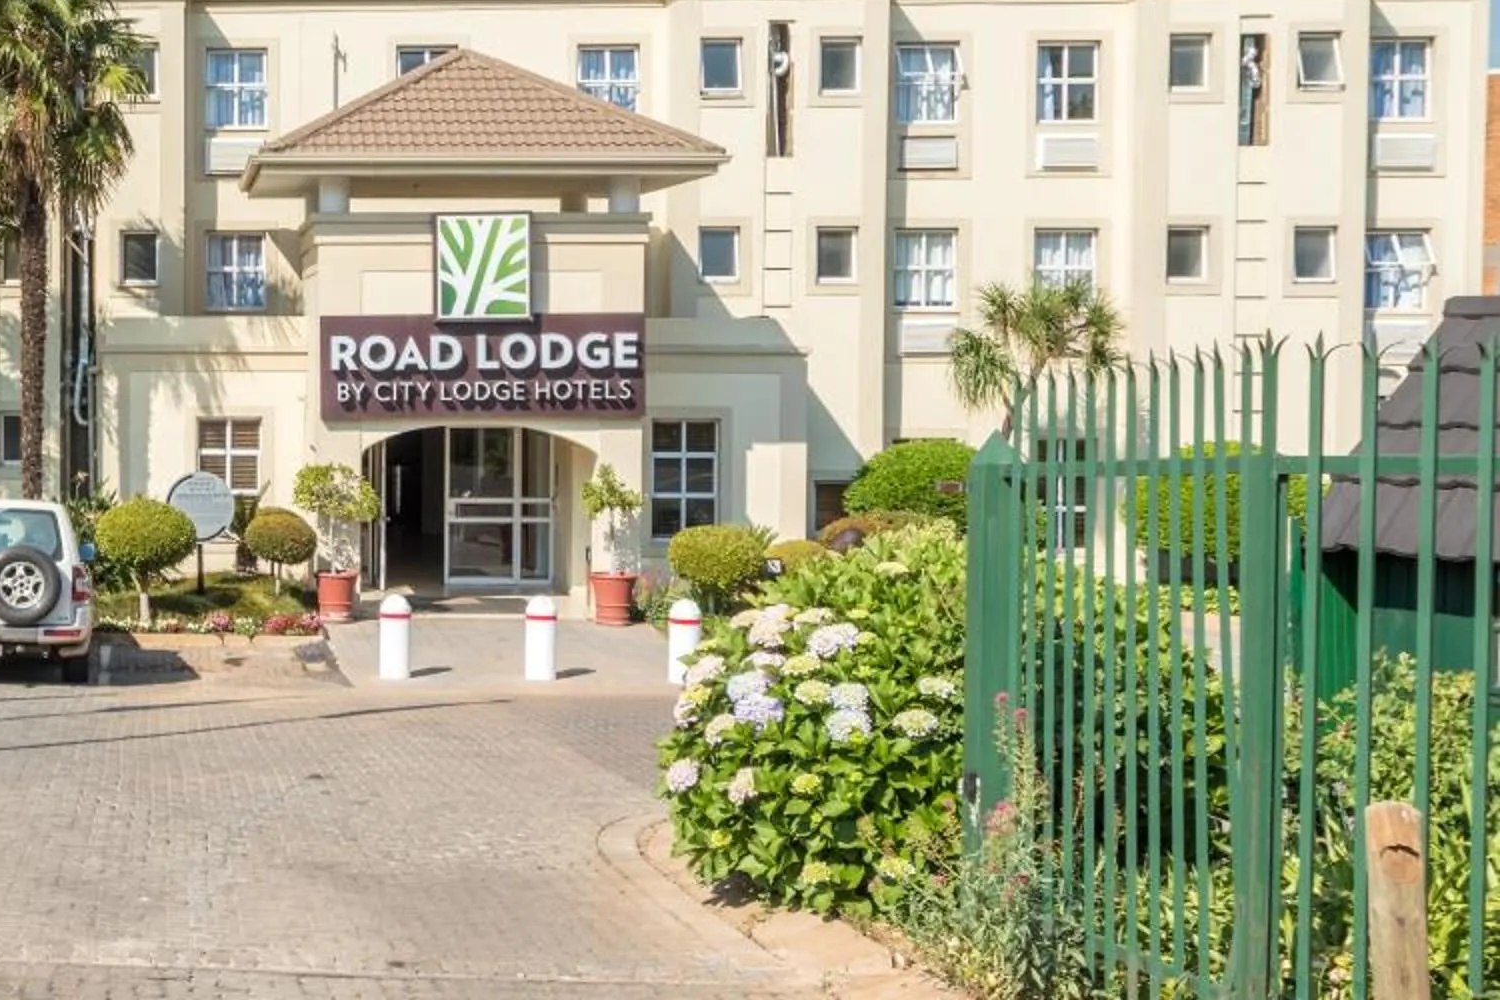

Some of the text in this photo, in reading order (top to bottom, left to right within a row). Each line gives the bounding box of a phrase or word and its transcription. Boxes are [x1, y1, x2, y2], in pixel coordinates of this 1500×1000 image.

[331, 333, 639, 371] ROAD LODGE
[336, 379, 632, 402] BY CITY LODGE HOTELS
